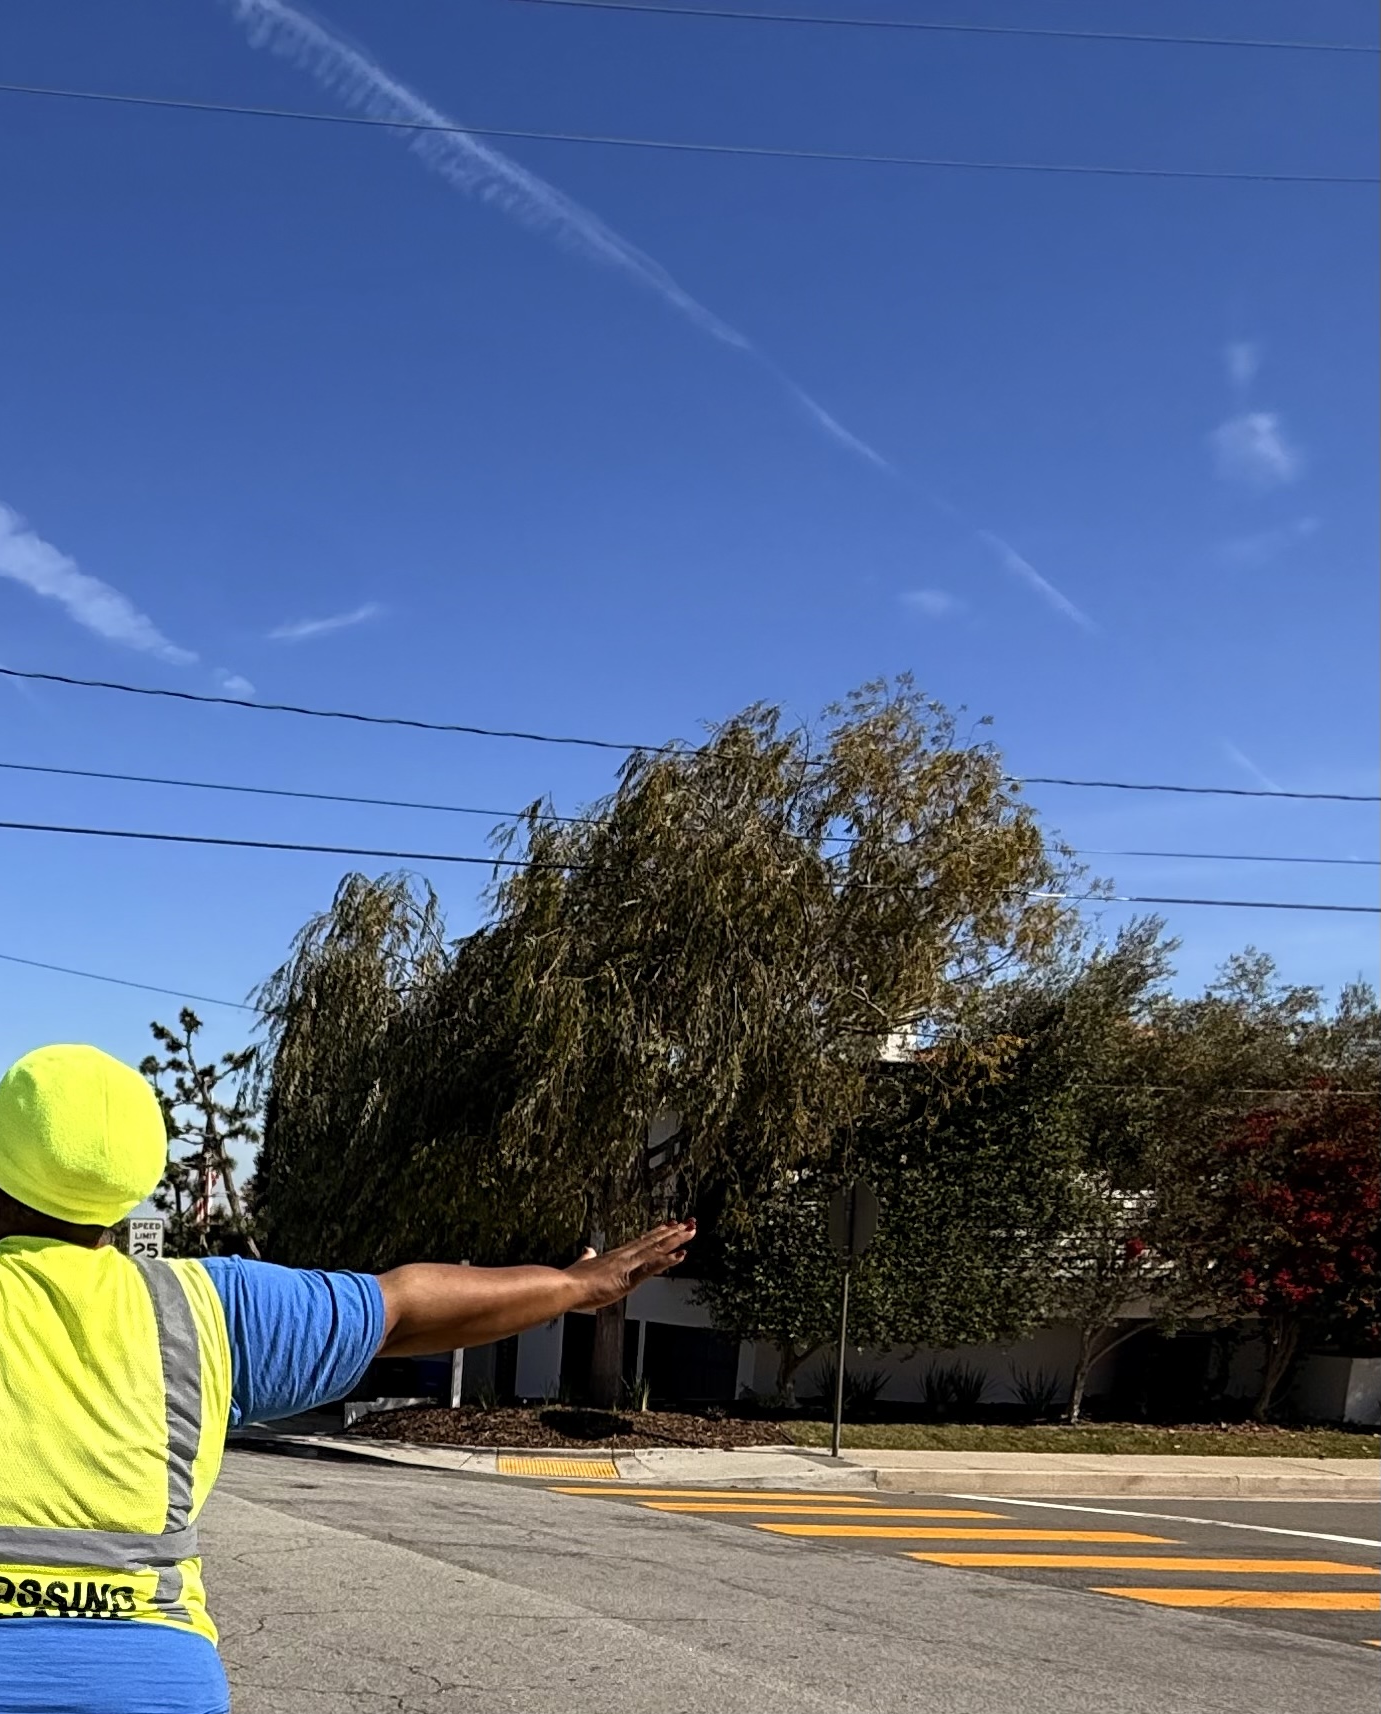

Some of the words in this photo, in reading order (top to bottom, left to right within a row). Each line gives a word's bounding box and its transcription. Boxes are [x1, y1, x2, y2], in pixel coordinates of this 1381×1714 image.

[132, 1222, 161, 1230] SPEED
[134, 1232, 157, 1240] LIMIT
[133, 1242, 158, 1259] 25
